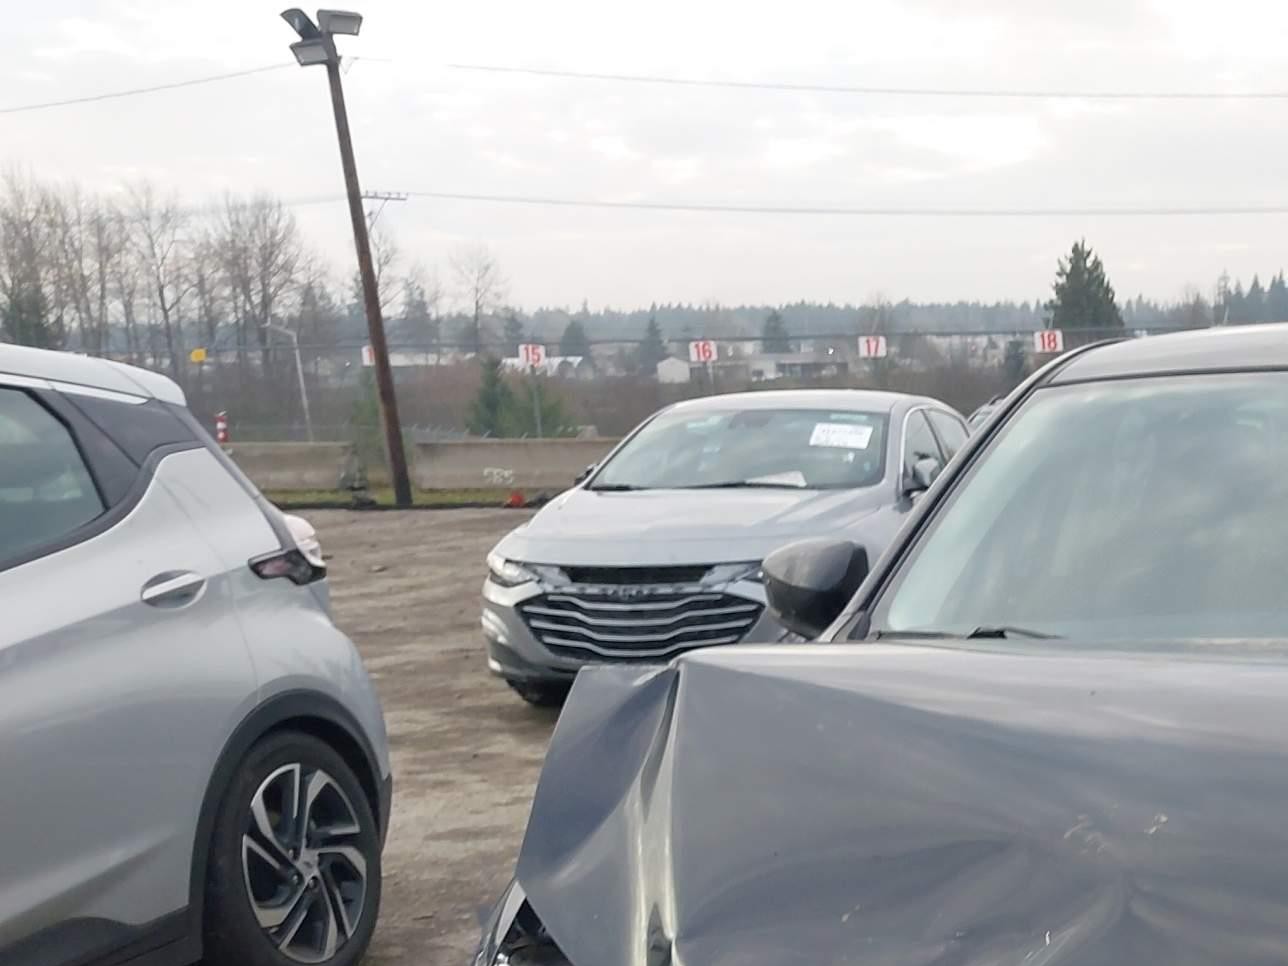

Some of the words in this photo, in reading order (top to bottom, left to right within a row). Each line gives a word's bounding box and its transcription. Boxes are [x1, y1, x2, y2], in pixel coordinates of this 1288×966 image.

[694, 341, 712, 361] 16
[865, 337, 881, 356] 17
[1039, 332, 1057, 352] 18
[523, 345, 541, 367] 15
